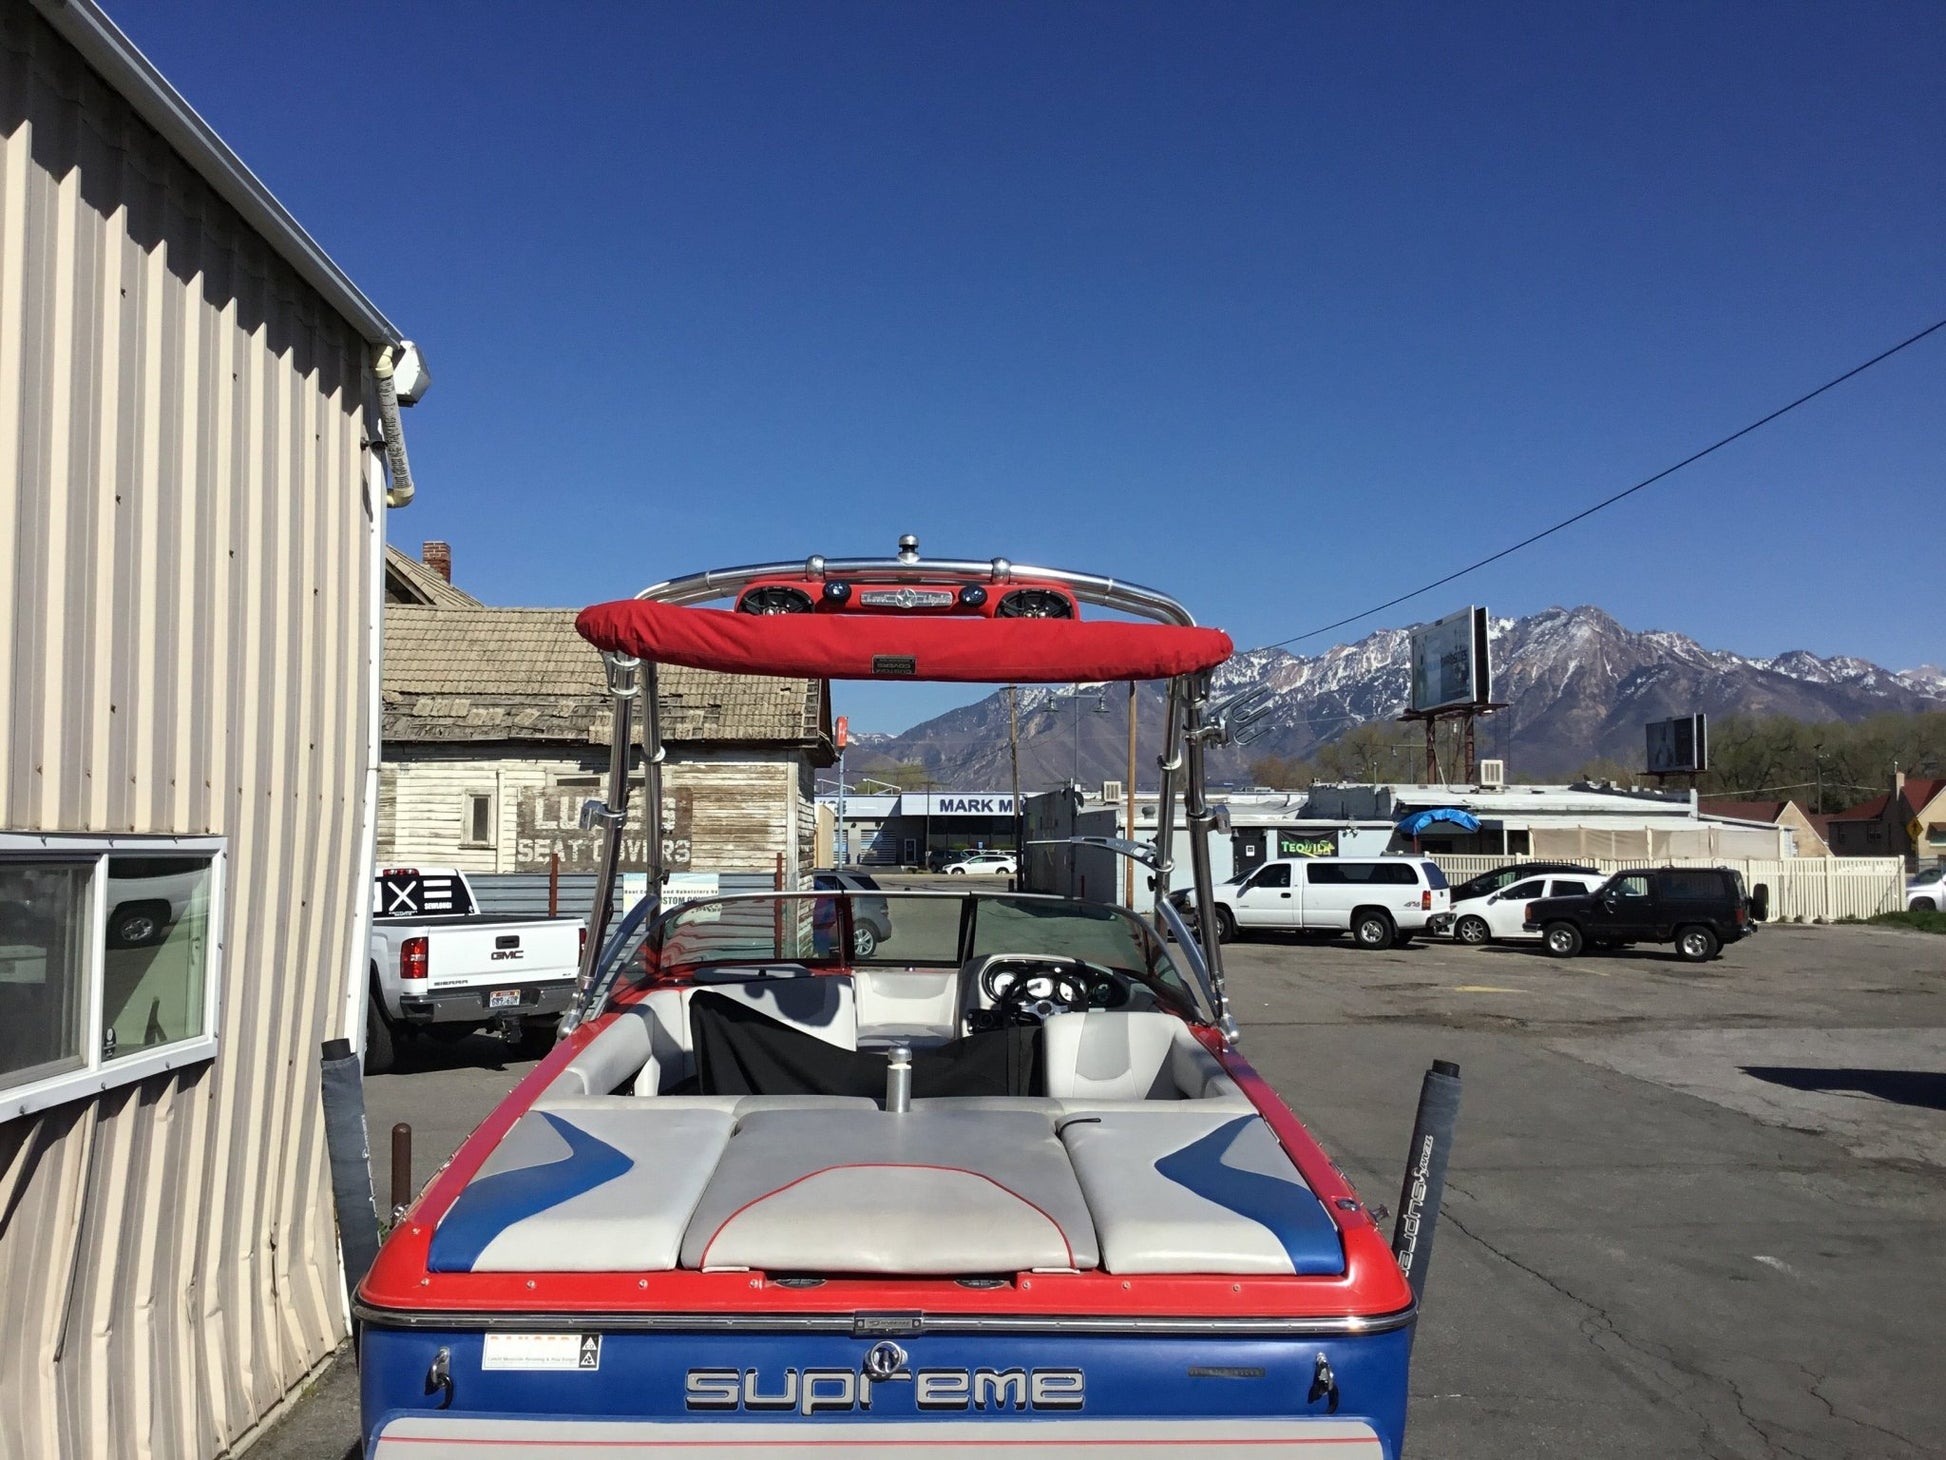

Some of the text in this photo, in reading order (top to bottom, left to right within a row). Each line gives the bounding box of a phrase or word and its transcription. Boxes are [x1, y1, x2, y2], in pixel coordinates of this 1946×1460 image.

[534, 796, 676, 831] LUES
[940, 799, 993, 813] MARK
[517, 838, 691, 864] SEAT CVRS
[1281, 841, 1333, 856] TEQUILA
[491, 950, 524, 960] GMC
[685, 1368, 1087, 1417] supreme
